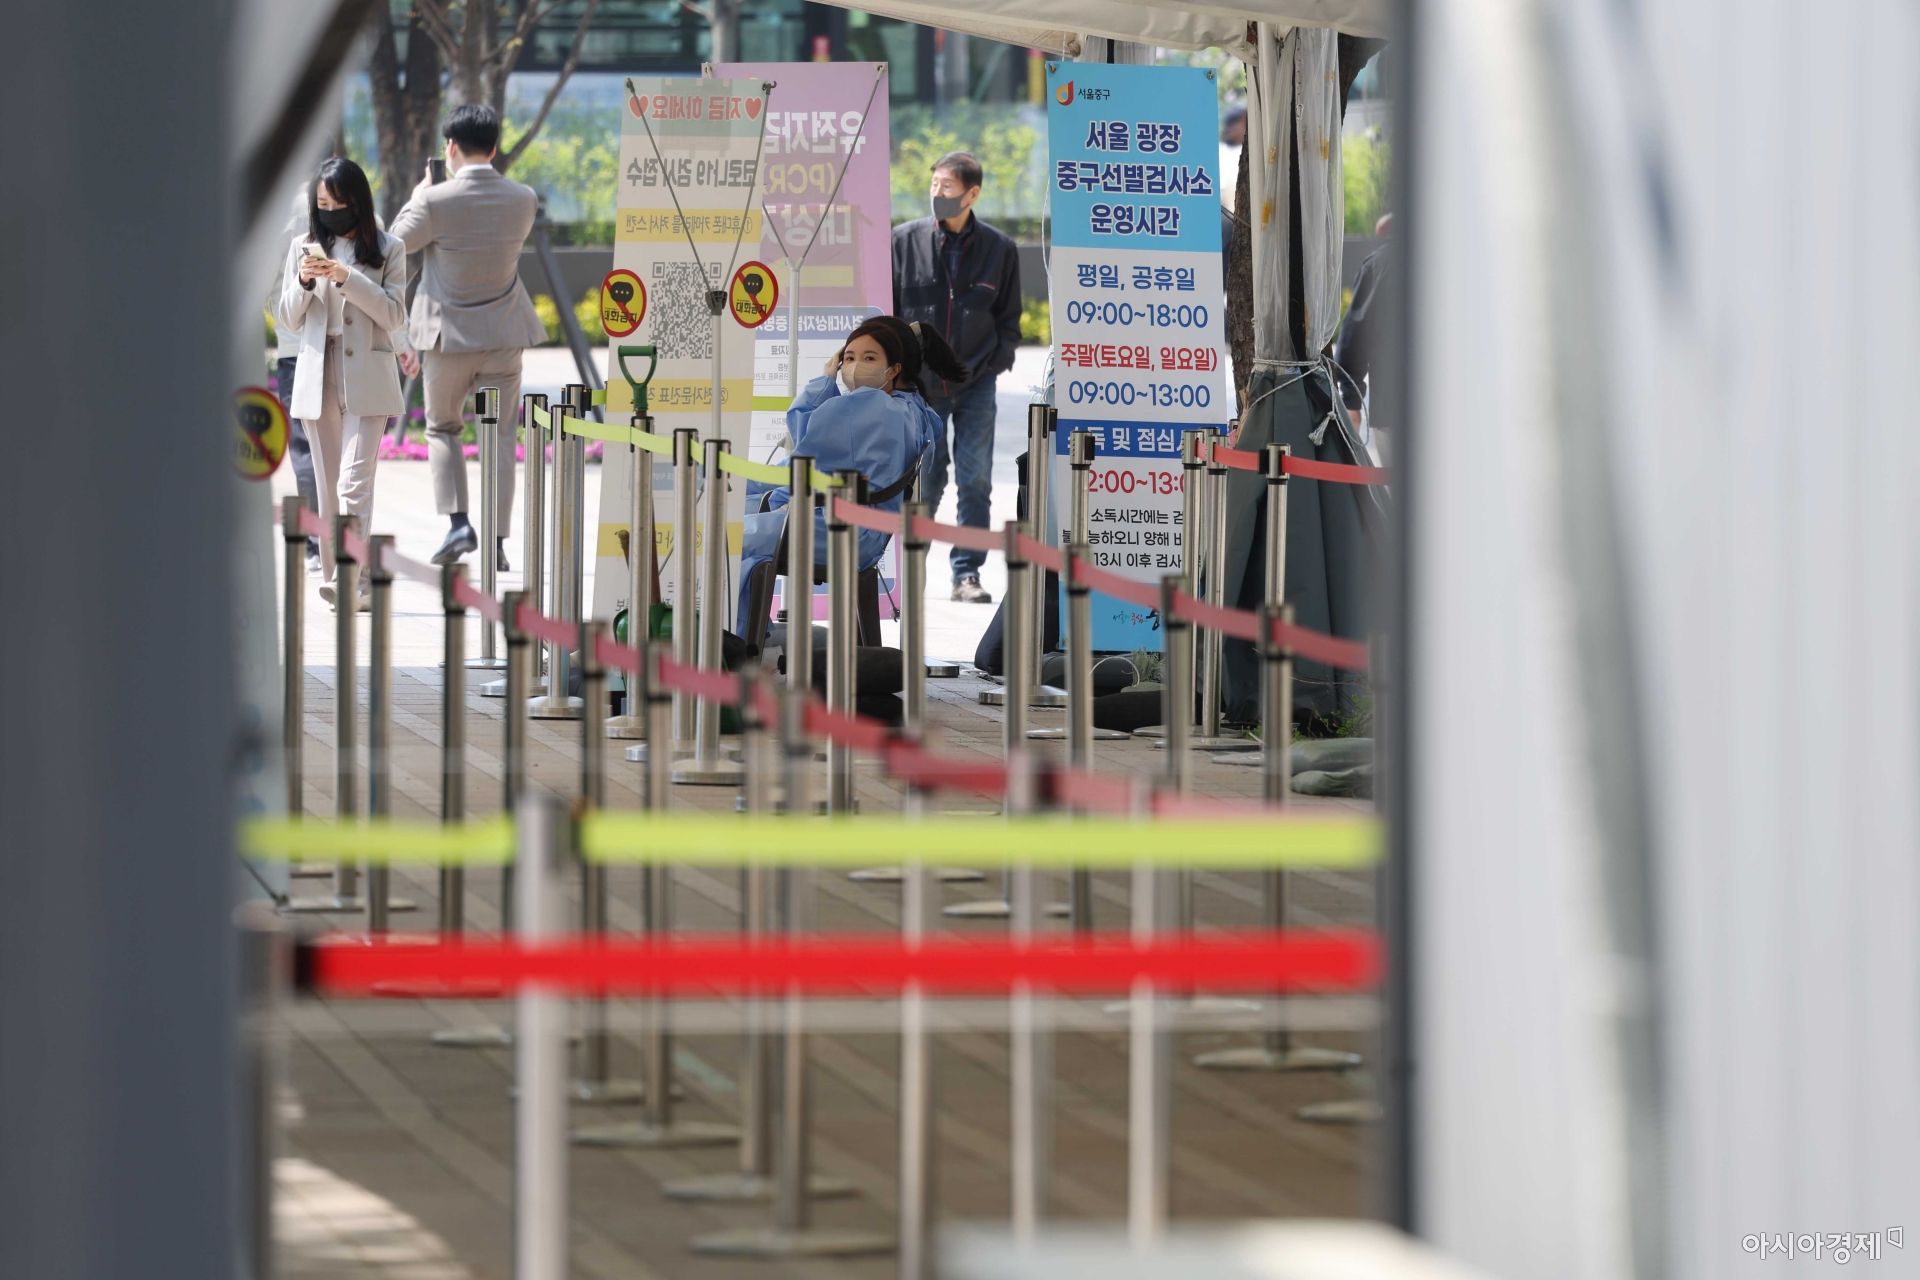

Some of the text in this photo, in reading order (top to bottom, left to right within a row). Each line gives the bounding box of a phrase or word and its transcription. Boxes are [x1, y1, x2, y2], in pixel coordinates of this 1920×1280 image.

[1078, 88, 1110, 100] 서울중구
[1086, 121, 1180, 153] 서울 광장
[1057, 161, 1212, 195] 중구선별검사소
[1091, 203, 1180, 236] 운영시간
[1077, 264, 1195, 291] 평일, 공휴일
[736, 301, 767, 315] 대화금지
[1067, 301, 1208, 328] 09:00~18:00
[1061, 344, 1217, 371] 주말(토요일, 일요일)
[1069, 381, 1210, 407] 09:00~13:00
[1112, 427, 1130, 450] 및
[1137, 428, 1175, 452] 점심
[1091, 508, 1168, 524] 소독시간에는
[1144, 532, 1169, 546] 양해
[1094, 552, 1121, 567] 13시
[1126, 553, 1151, 567] 이후
